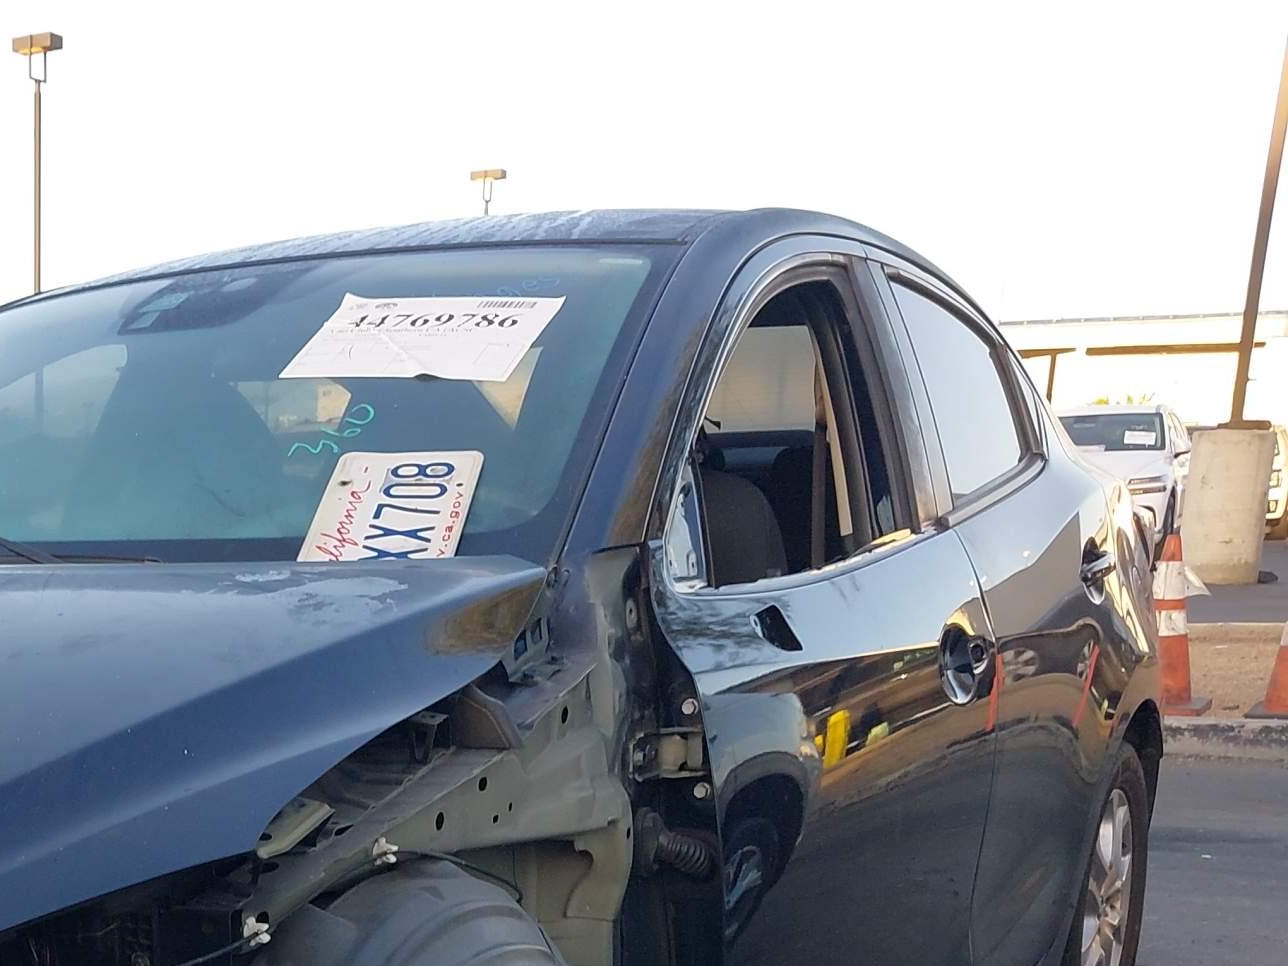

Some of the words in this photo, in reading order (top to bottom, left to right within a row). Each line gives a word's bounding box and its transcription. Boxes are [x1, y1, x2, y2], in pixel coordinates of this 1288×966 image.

[347, 311, 525, 329] 44769786
[315, 479, 372, 561] lifornia
[358, 461, 456, 560] XX708
